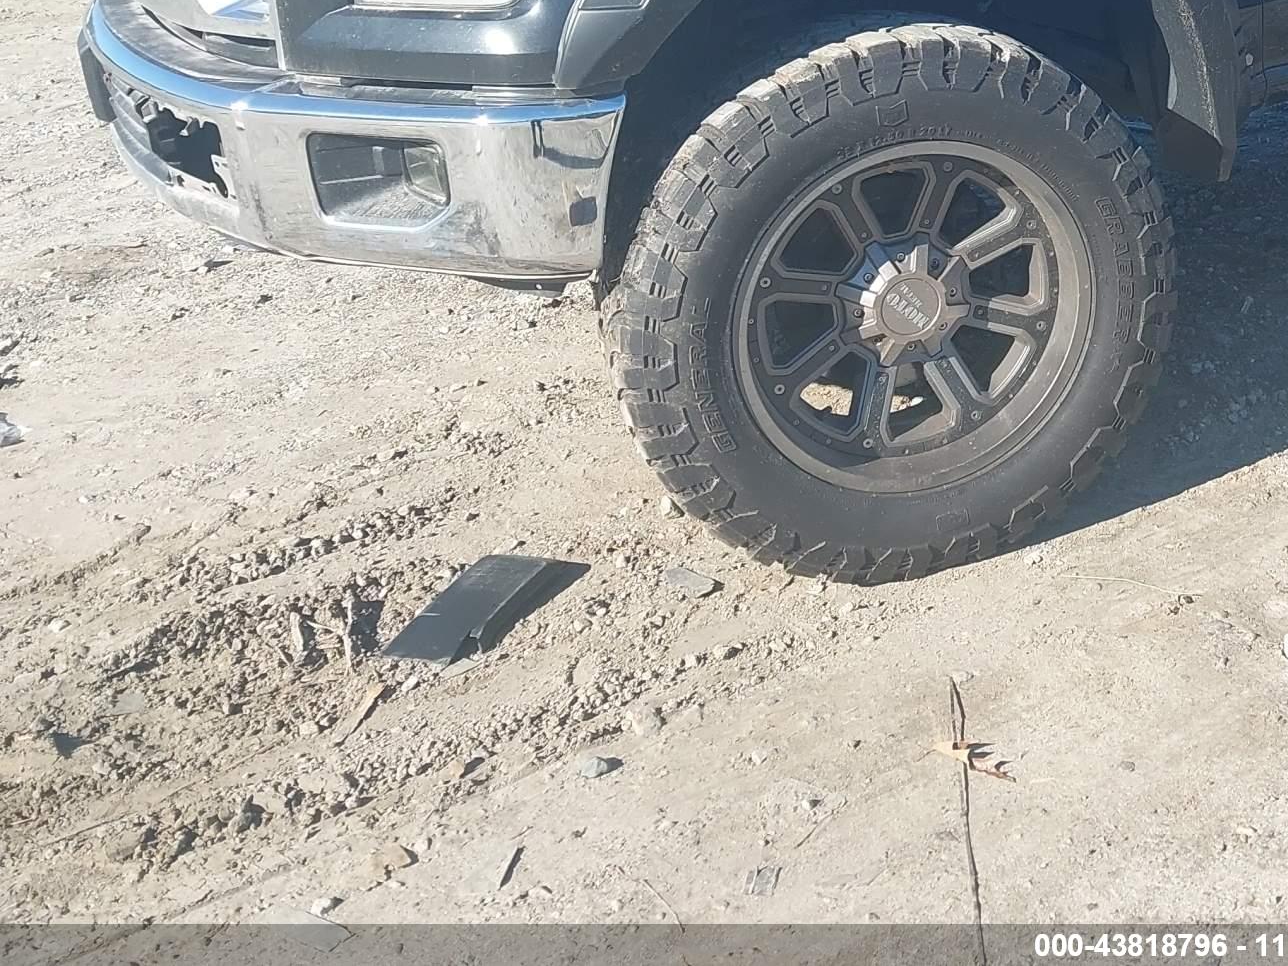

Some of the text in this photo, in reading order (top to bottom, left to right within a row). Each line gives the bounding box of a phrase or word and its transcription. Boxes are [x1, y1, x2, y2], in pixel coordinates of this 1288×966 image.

[886, 293, 930, 330] MOTO
[1095, 196, 1135, 345] GRABBER
[689, 297, 737, 453] GENERAL
